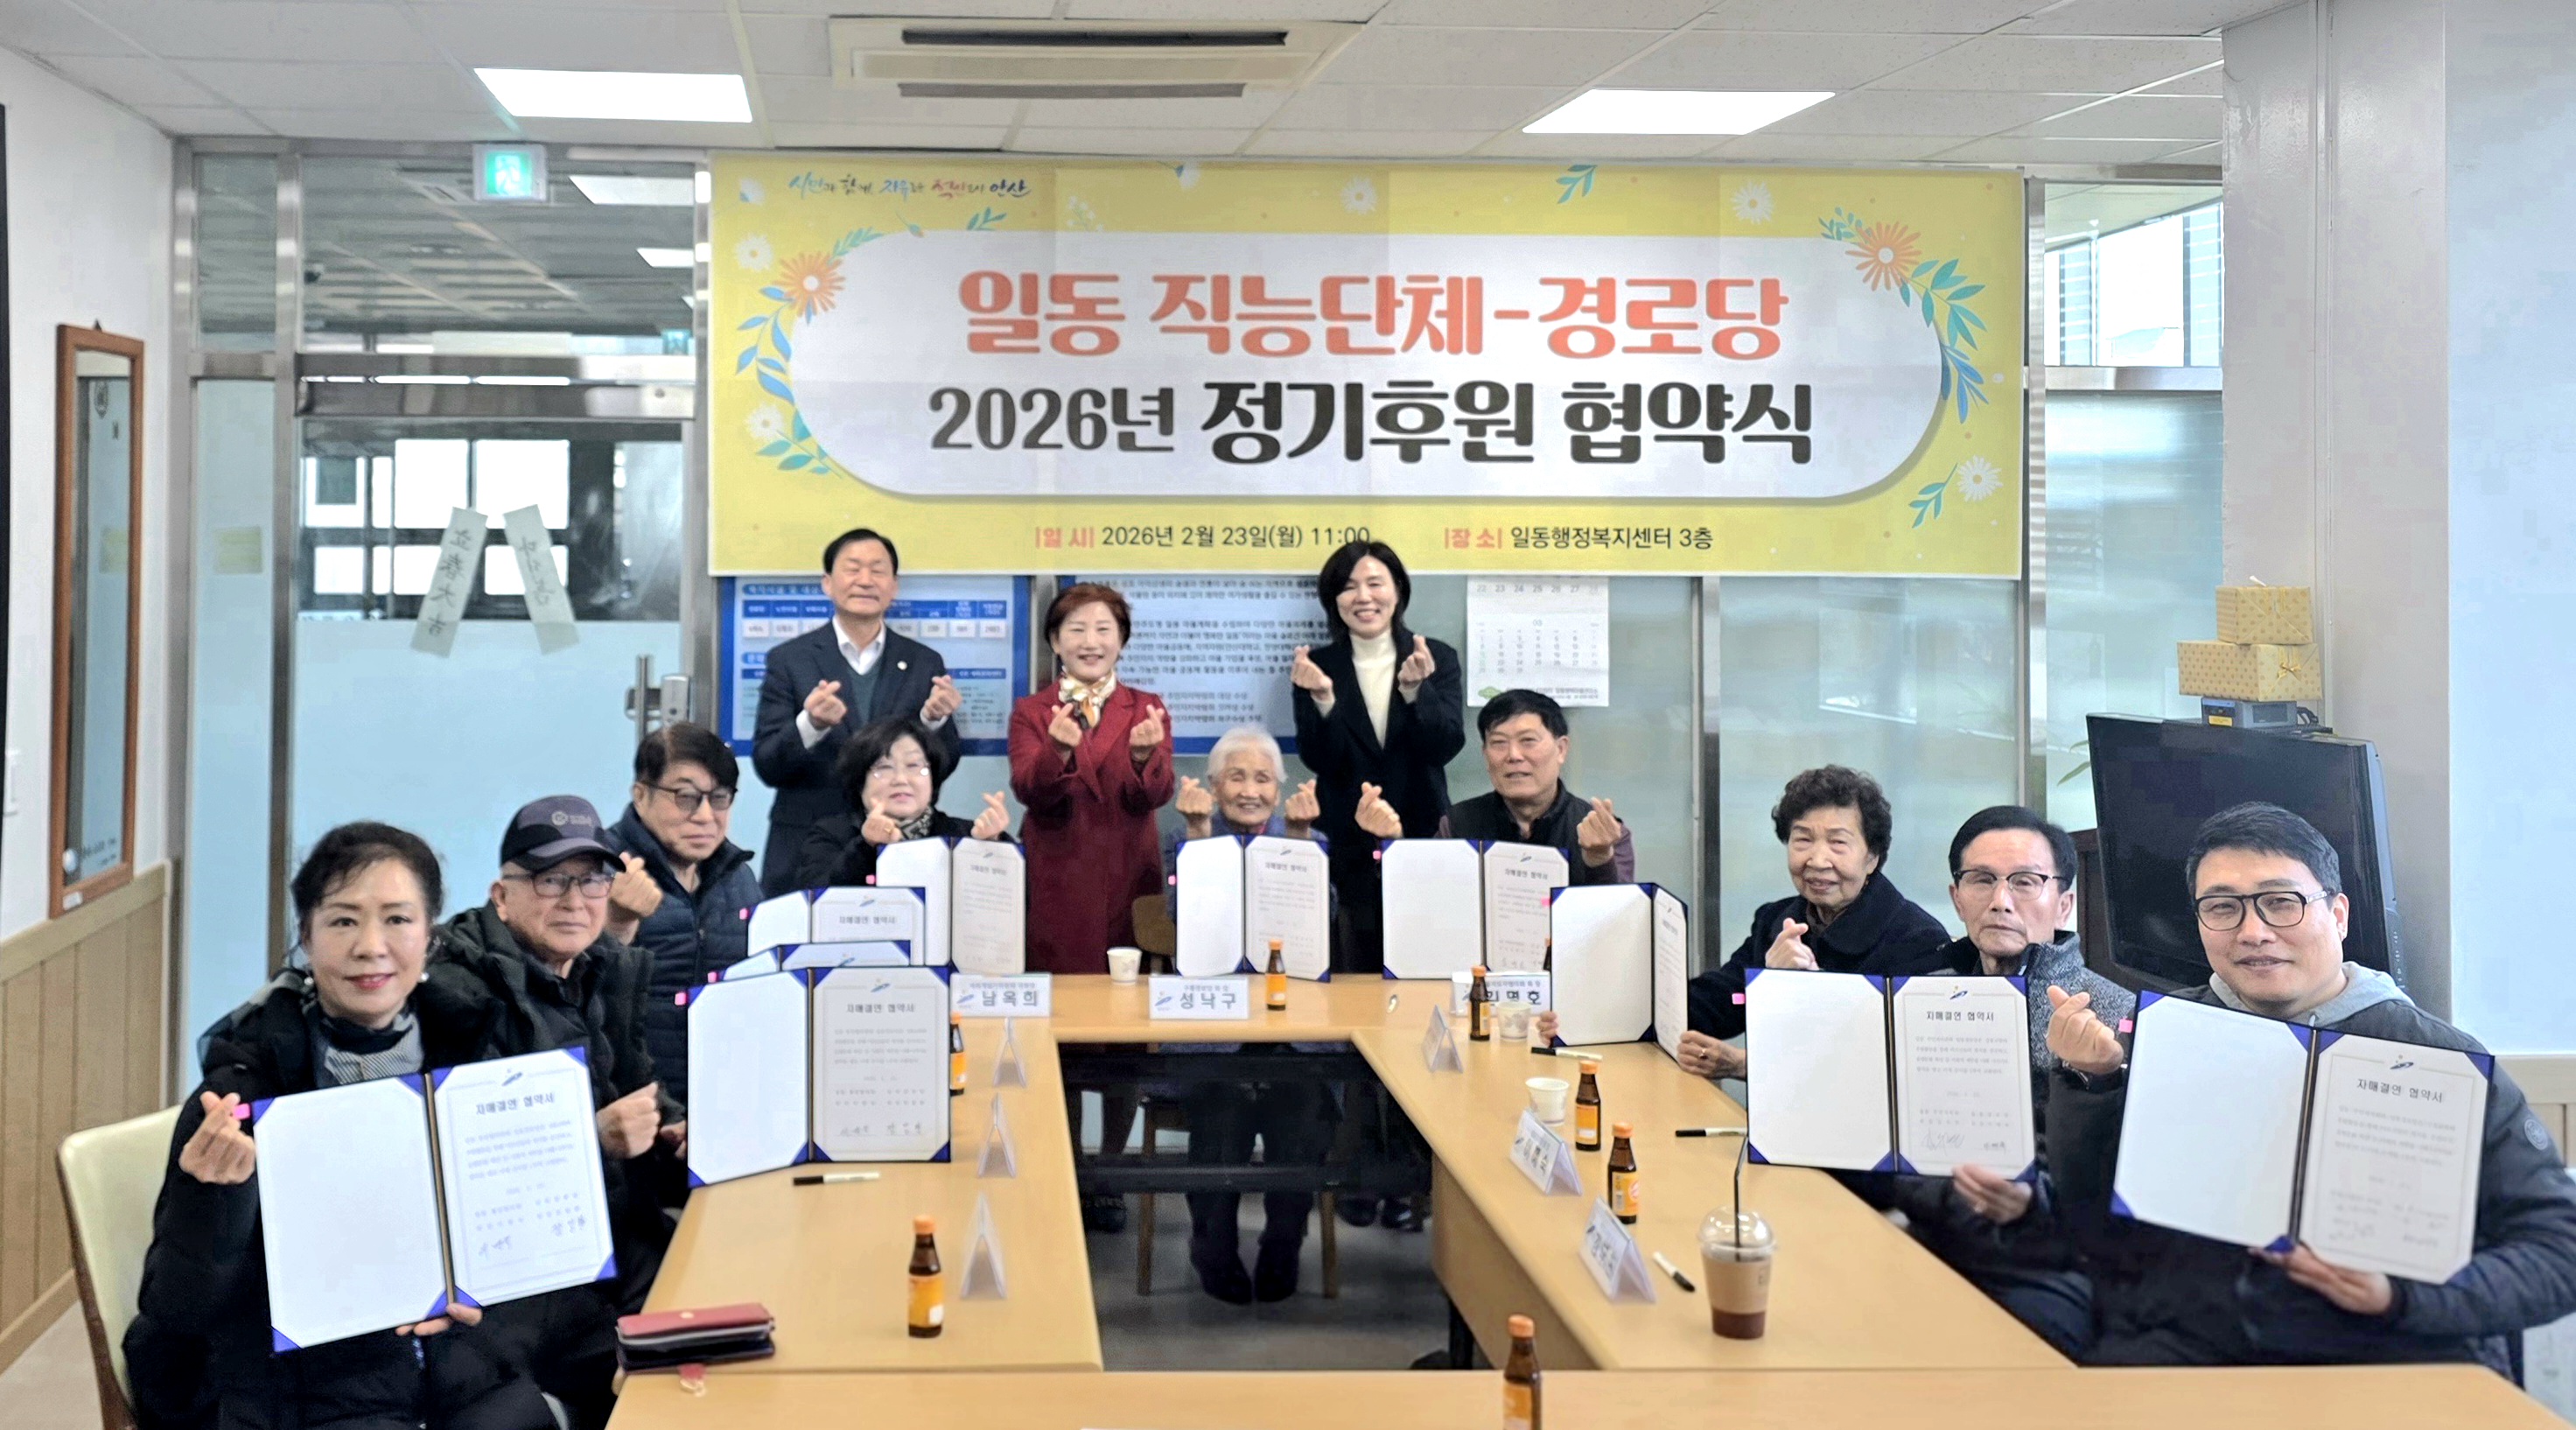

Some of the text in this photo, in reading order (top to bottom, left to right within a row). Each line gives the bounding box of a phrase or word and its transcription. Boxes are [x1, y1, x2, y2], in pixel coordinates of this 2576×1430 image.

[990, 179, 1031, 198] 안산
[959, 270, 1789, 361] 일동 직능단체-경로당
[928, 381, 1811, 465] 2026년 정기후원 협약식
[1102, 527, 1173, 546] 2026년
[1181, 527, 1214, 546] 2월
[1222, 526, 1303, 548] 23일(월)
[1312, 526, 1369, 545] 11:00
[1511, 527, 1672, 549] 일동행정복지센터
[1680, 527, 1713, 549] 3층
[1571, 585, 1578, 593] 27
[1180, 992, 1236, 1010] 성낙구
[2356, 1078, 2443, 1104] 자매결연 협약서
